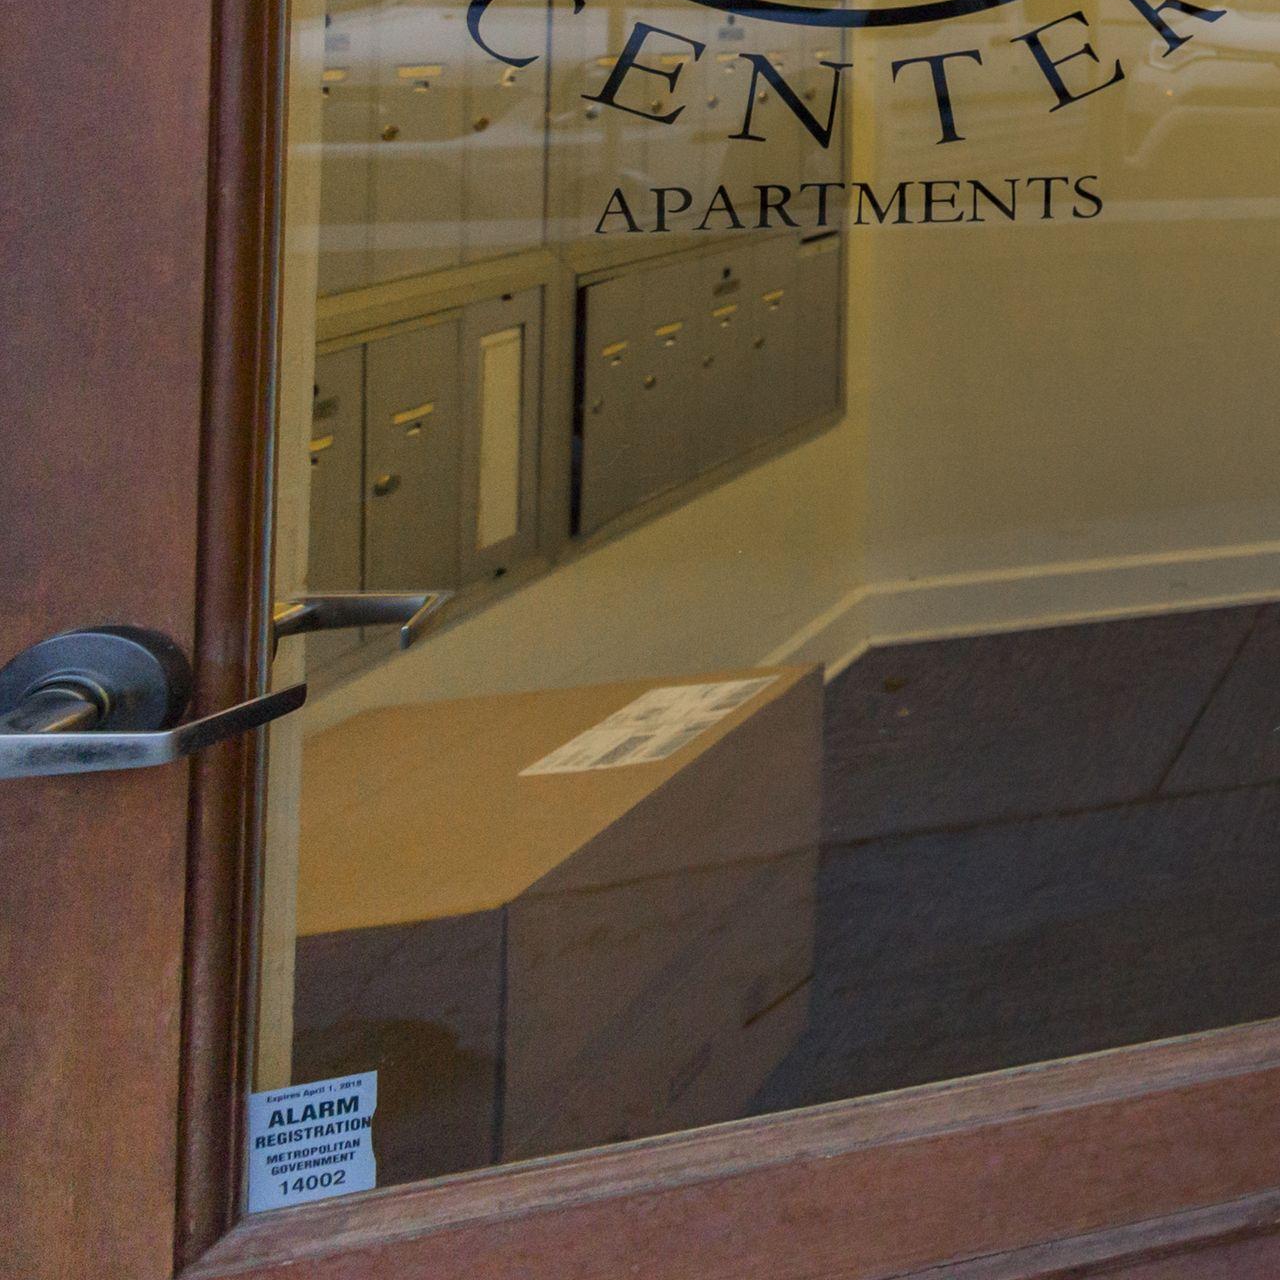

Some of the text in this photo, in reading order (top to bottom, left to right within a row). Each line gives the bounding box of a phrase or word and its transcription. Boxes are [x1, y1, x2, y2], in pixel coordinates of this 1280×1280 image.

[595, 175, 1104, 234] APARTMENTS
[266, 1092, 301, 1103] Expires
[303, 1086, 325, 1097] April
[268, 1095, 360, 1128] ALARM
[254, 1116, 371, 1149] REGISTRATION
[266, 1138, 360, 1165] METROPOLITAN
[271, 1151, 356, 1176] GOVERNMENT
[279, 1170, 346, 1195] 14002
